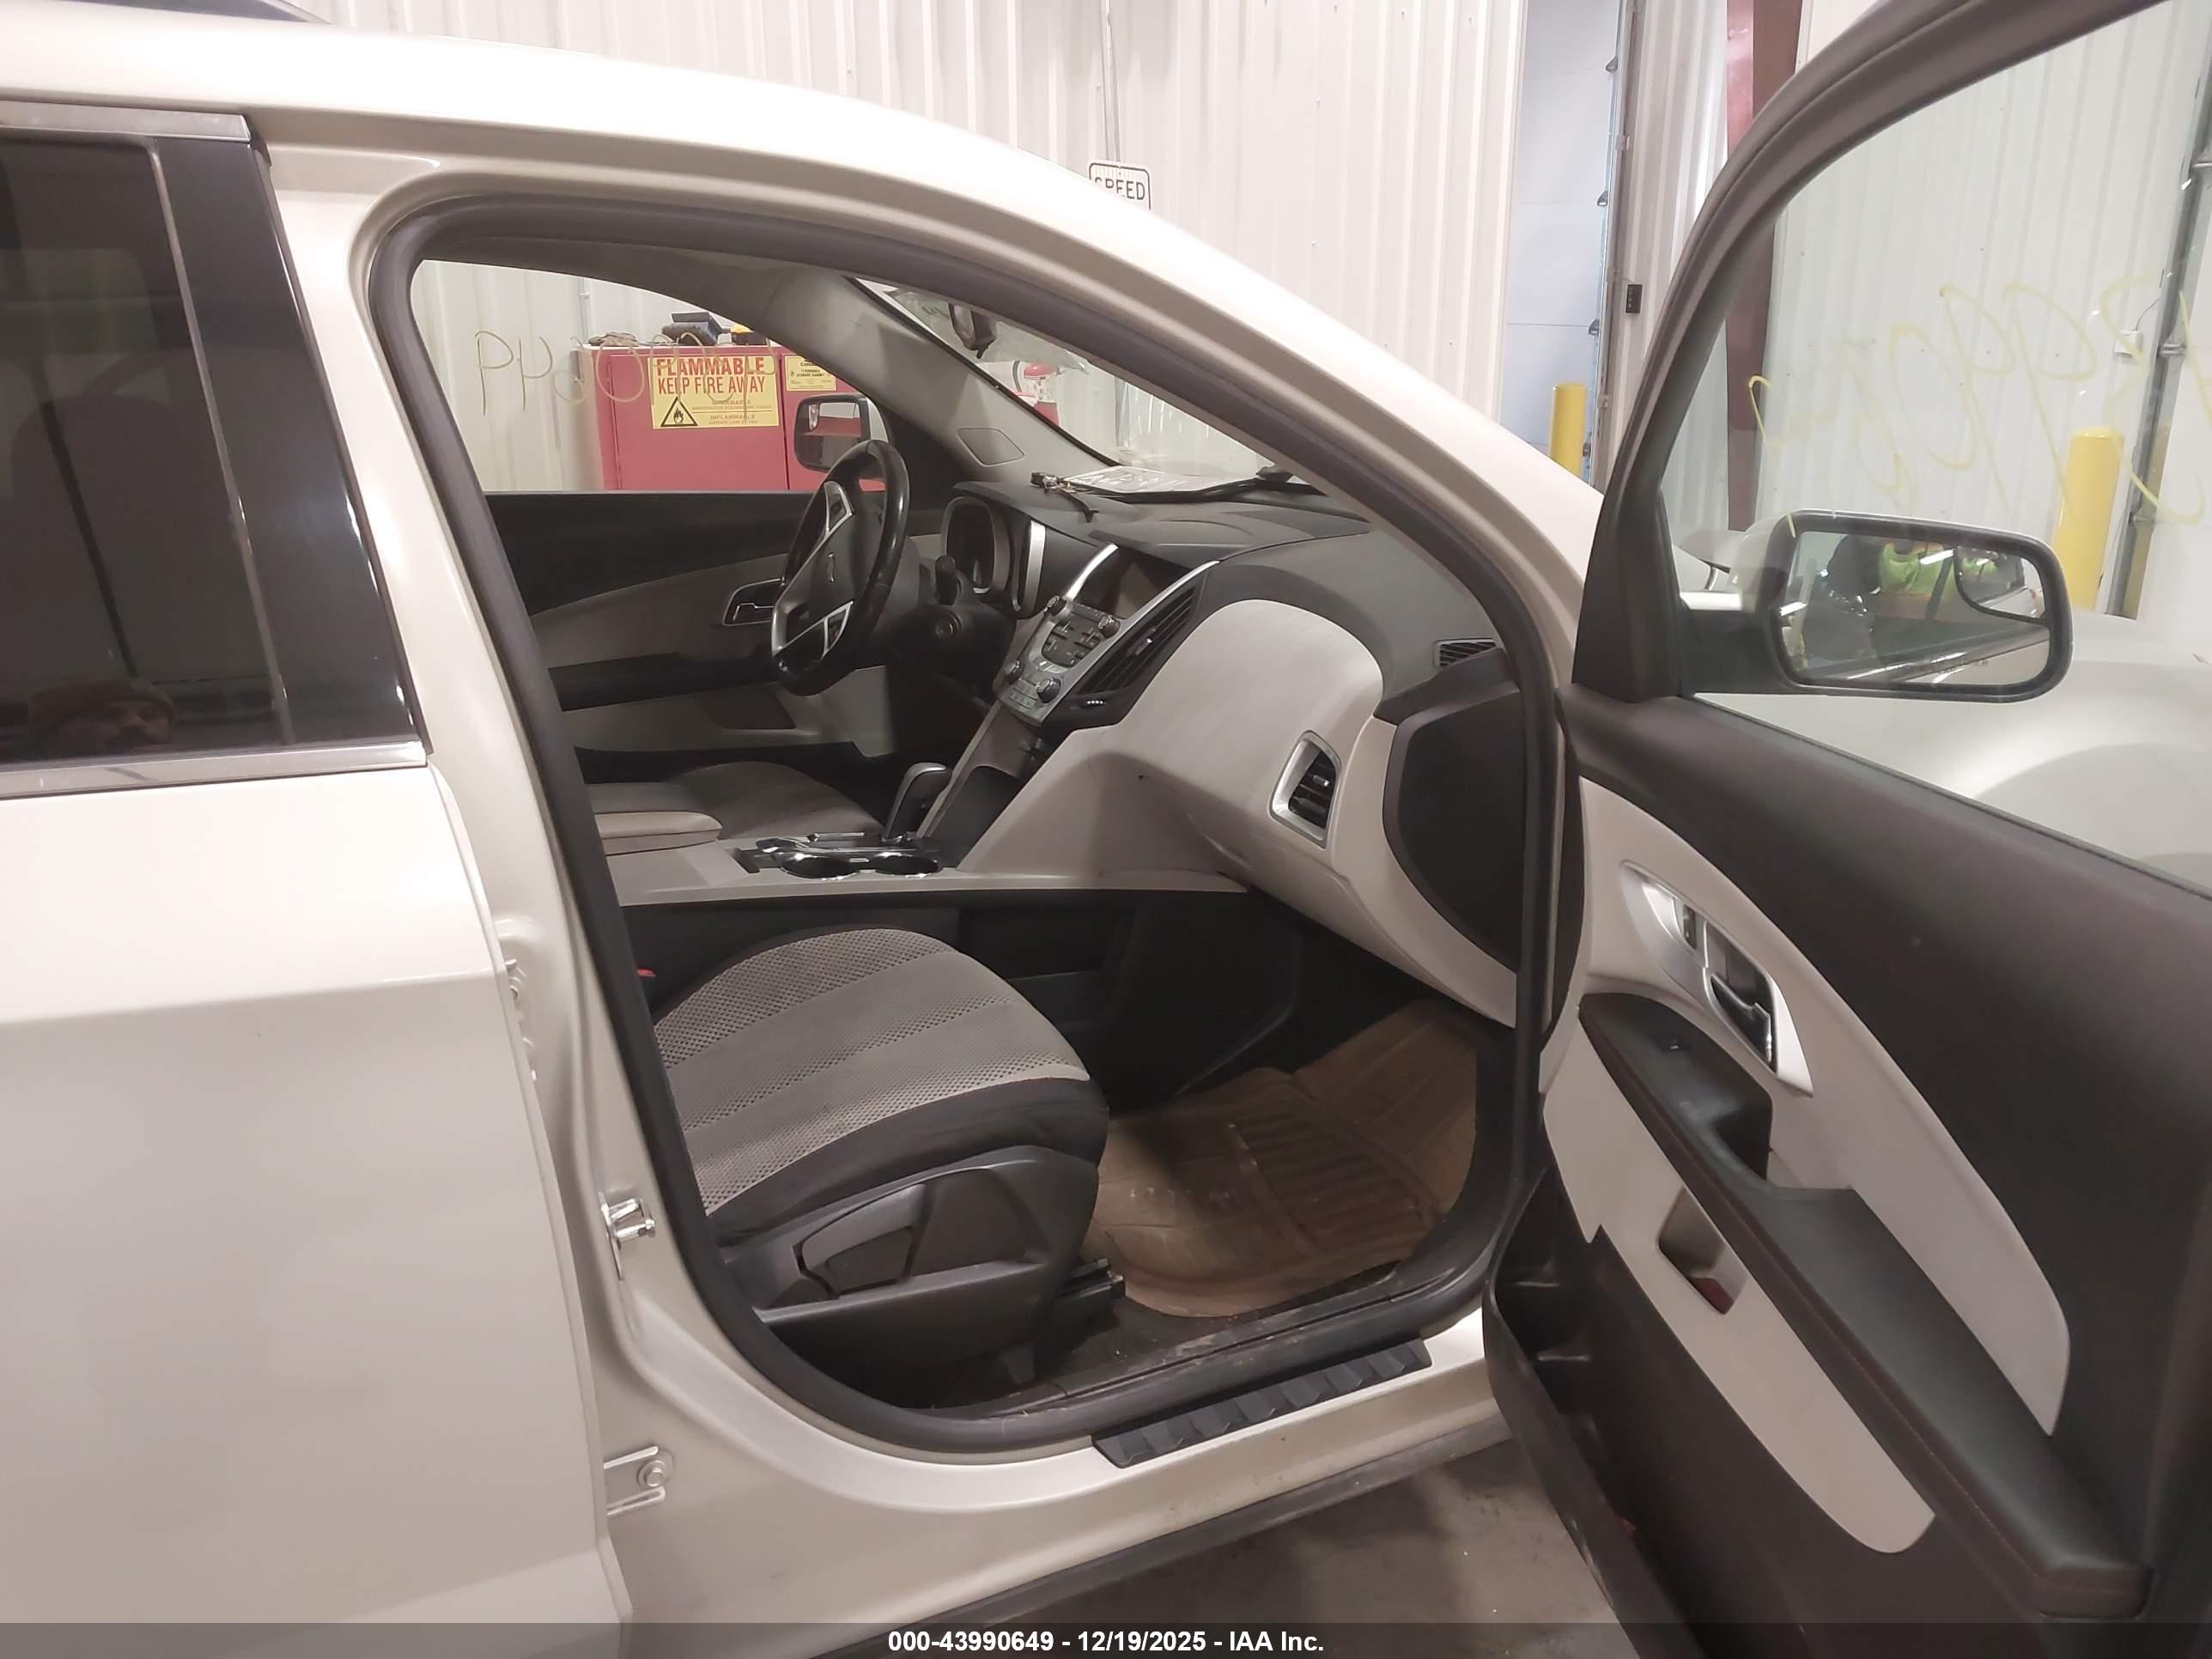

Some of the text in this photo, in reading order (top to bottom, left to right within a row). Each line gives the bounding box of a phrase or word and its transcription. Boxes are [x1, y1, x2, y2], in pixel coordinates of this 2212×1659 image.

[657, 357, 764, 376] FLAMMABLE
[695, 377, 724, 394] FIRE
[728, 375, 766, 393] AWAY
